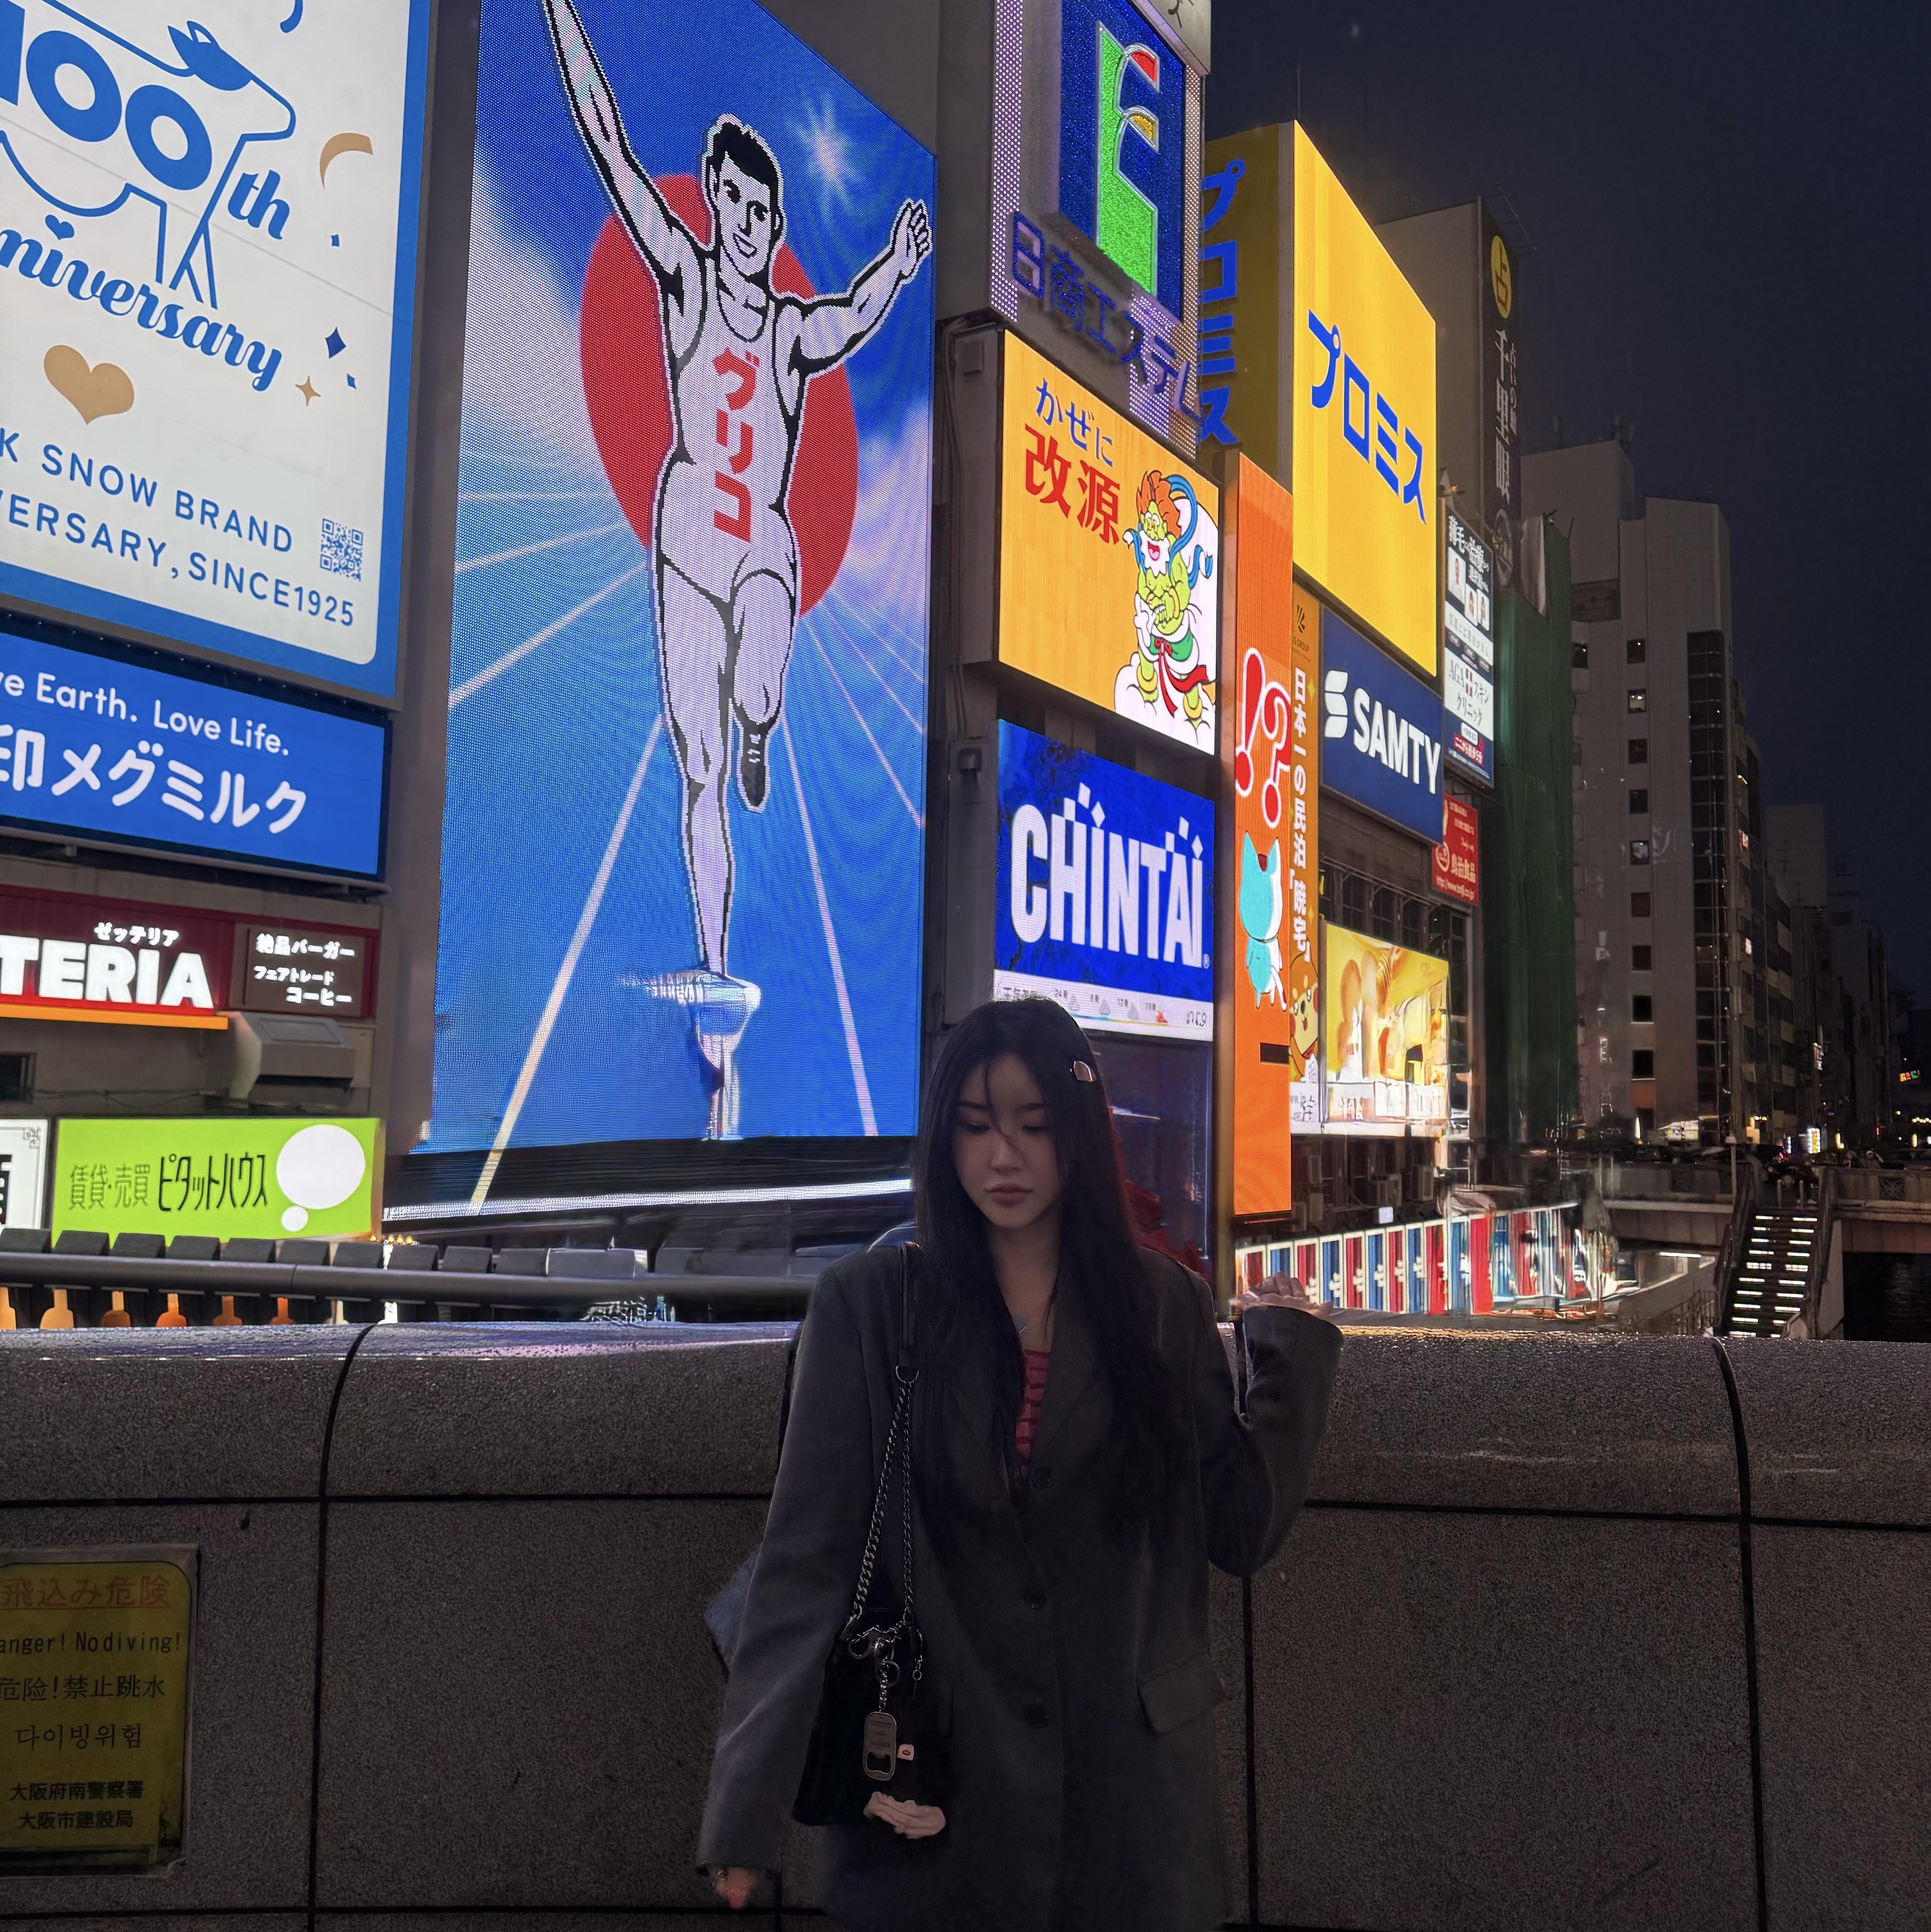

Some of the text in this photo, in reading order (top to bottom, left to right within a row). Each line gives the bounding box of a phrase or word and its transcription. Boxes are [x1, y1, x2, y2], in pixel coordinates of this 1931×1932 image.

[713, 347, 760, 543] グリコ
[1036, 378, 1113, 467] かぜに
[1308, 309, 1426, 524] プロミス
[1495, 329, 1510, 505] 千里眼
[42, 444, 157, 507] SNOW
[175, 490, 293, 553] BRAND
[1024, 423, 1120, 545] 改源
[37, 671, 138, 722] Earth.
[154, 699, 221, 740] Love
[230, 717, 289, 756] Life.
[1449, 660, 1464, 688] AGA
[1473, 681, 1490, 705] スキン
[1457, 692, 1482, 727] クリニック
[1353, 688, 1441, 794] SAMTY
[1011, 782, 1203, 968] CHINTAI
[94, 922, 179, 947] ゼッテリア
[0, 935, 214, 1009] TERIA
[253, 965, 335, 986] フェアトレード
[286, 987, 352, 1006] コーヒー
[69, 1163, 151, 1211] 賃貸・売買
[158, 1152, 268, 1212] ピタットハウス
[2, 1574, 170, 1607] 飛込み危険
[9, 1781, 144, 1801] 大阪府南警察署
[18, 1810, 133, 1830] 大阪市建設局
